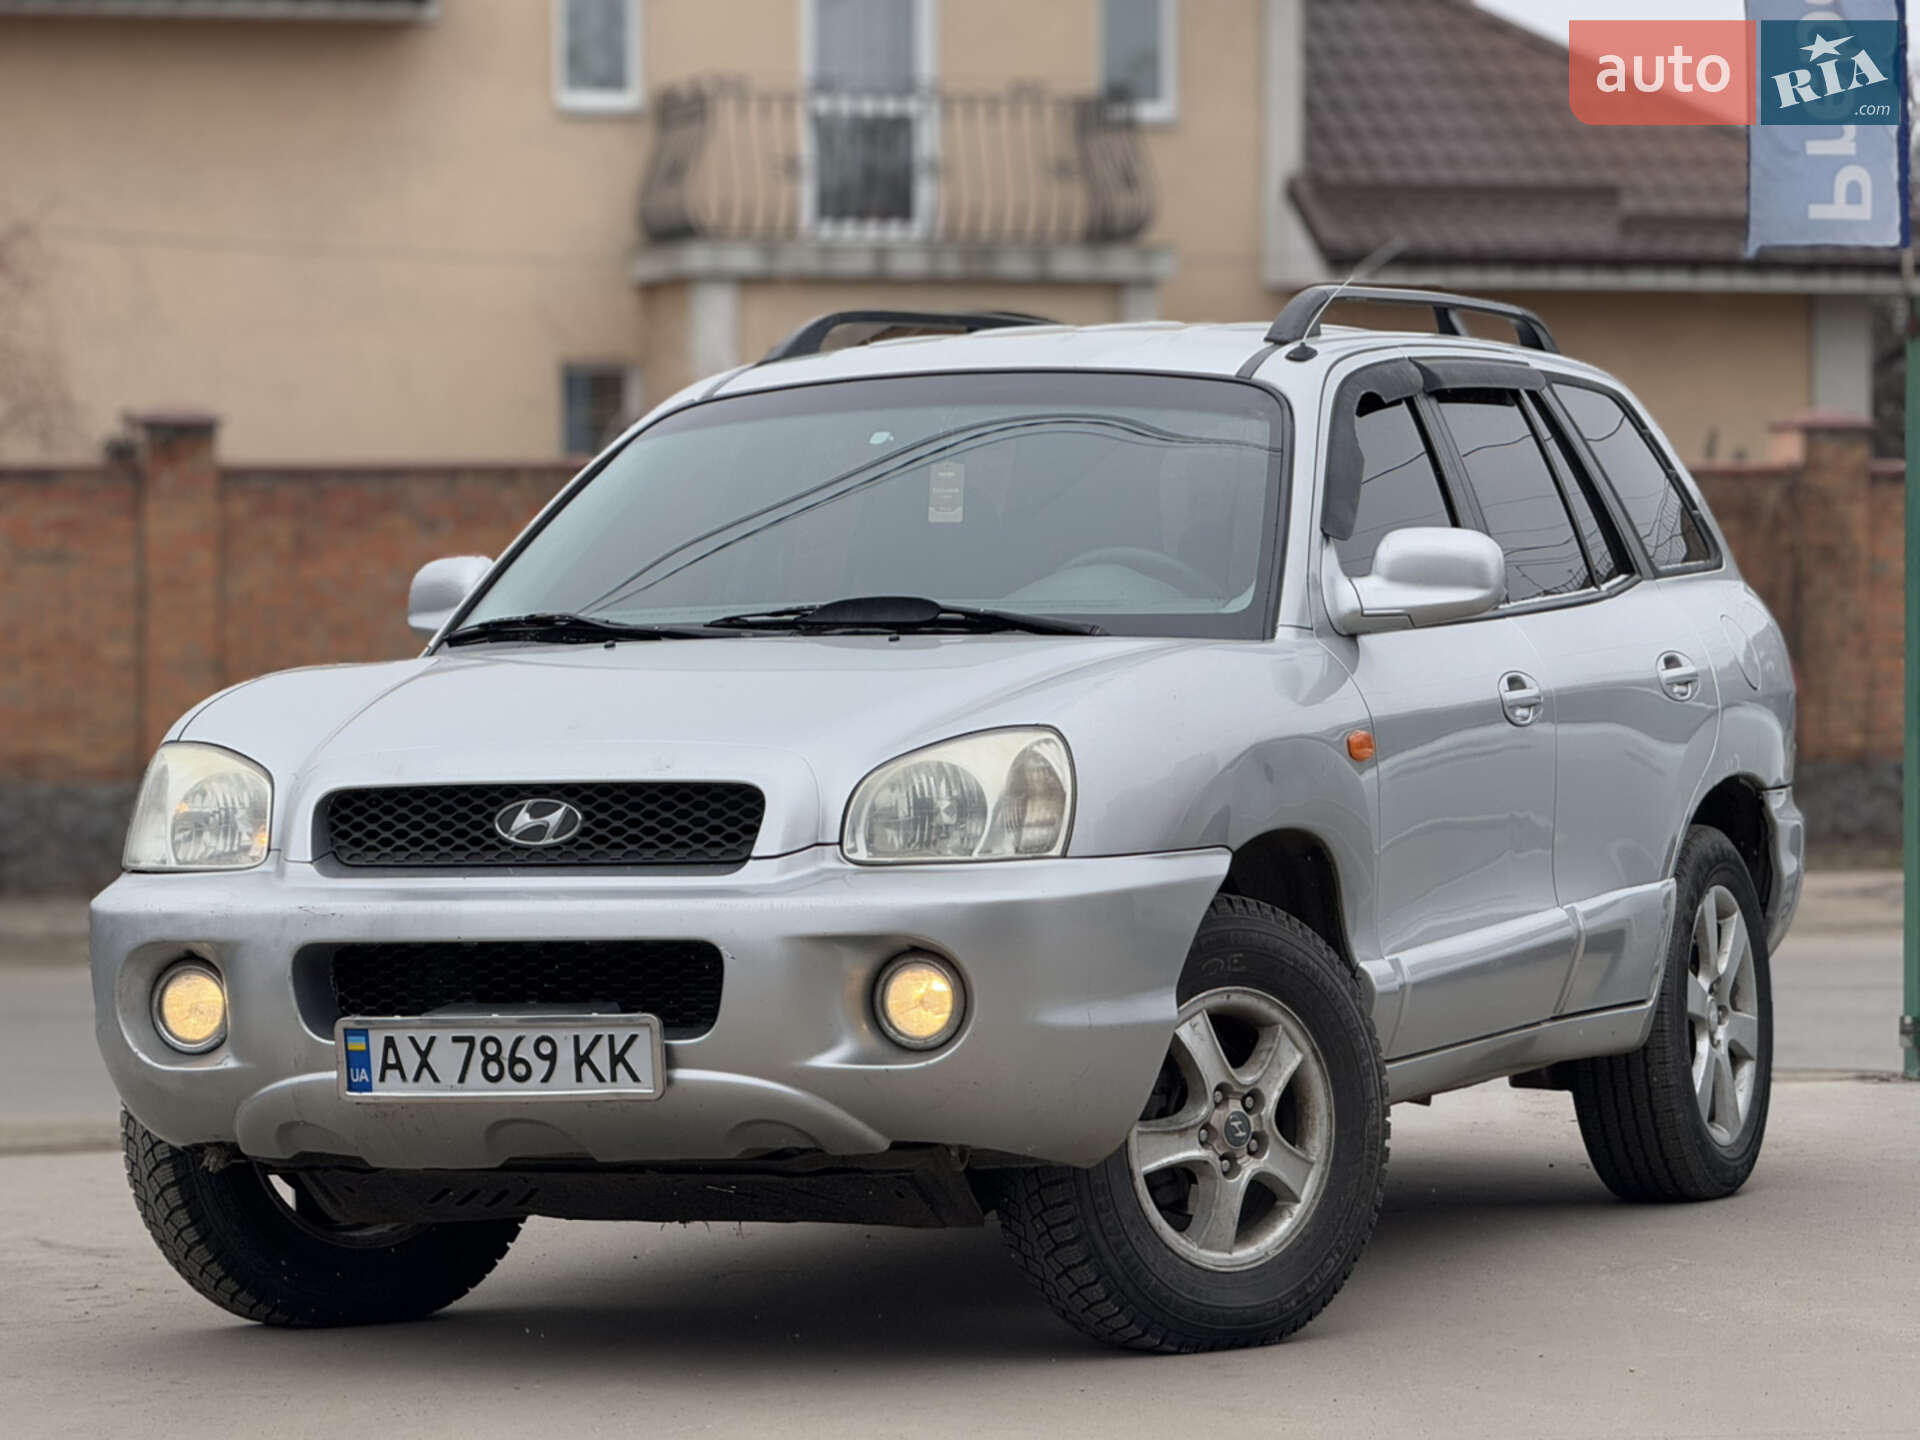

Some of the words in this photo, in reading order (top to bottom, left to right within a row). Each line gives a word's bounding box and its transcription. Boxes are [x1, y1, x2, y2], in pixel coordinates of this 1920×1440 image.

[350, 1067, 369, 1082] UA
[378, 1034, 440, 1083] AX
[451, 1034, 558, 1084] 7869
[573, 1033, 641, 1083] KK
